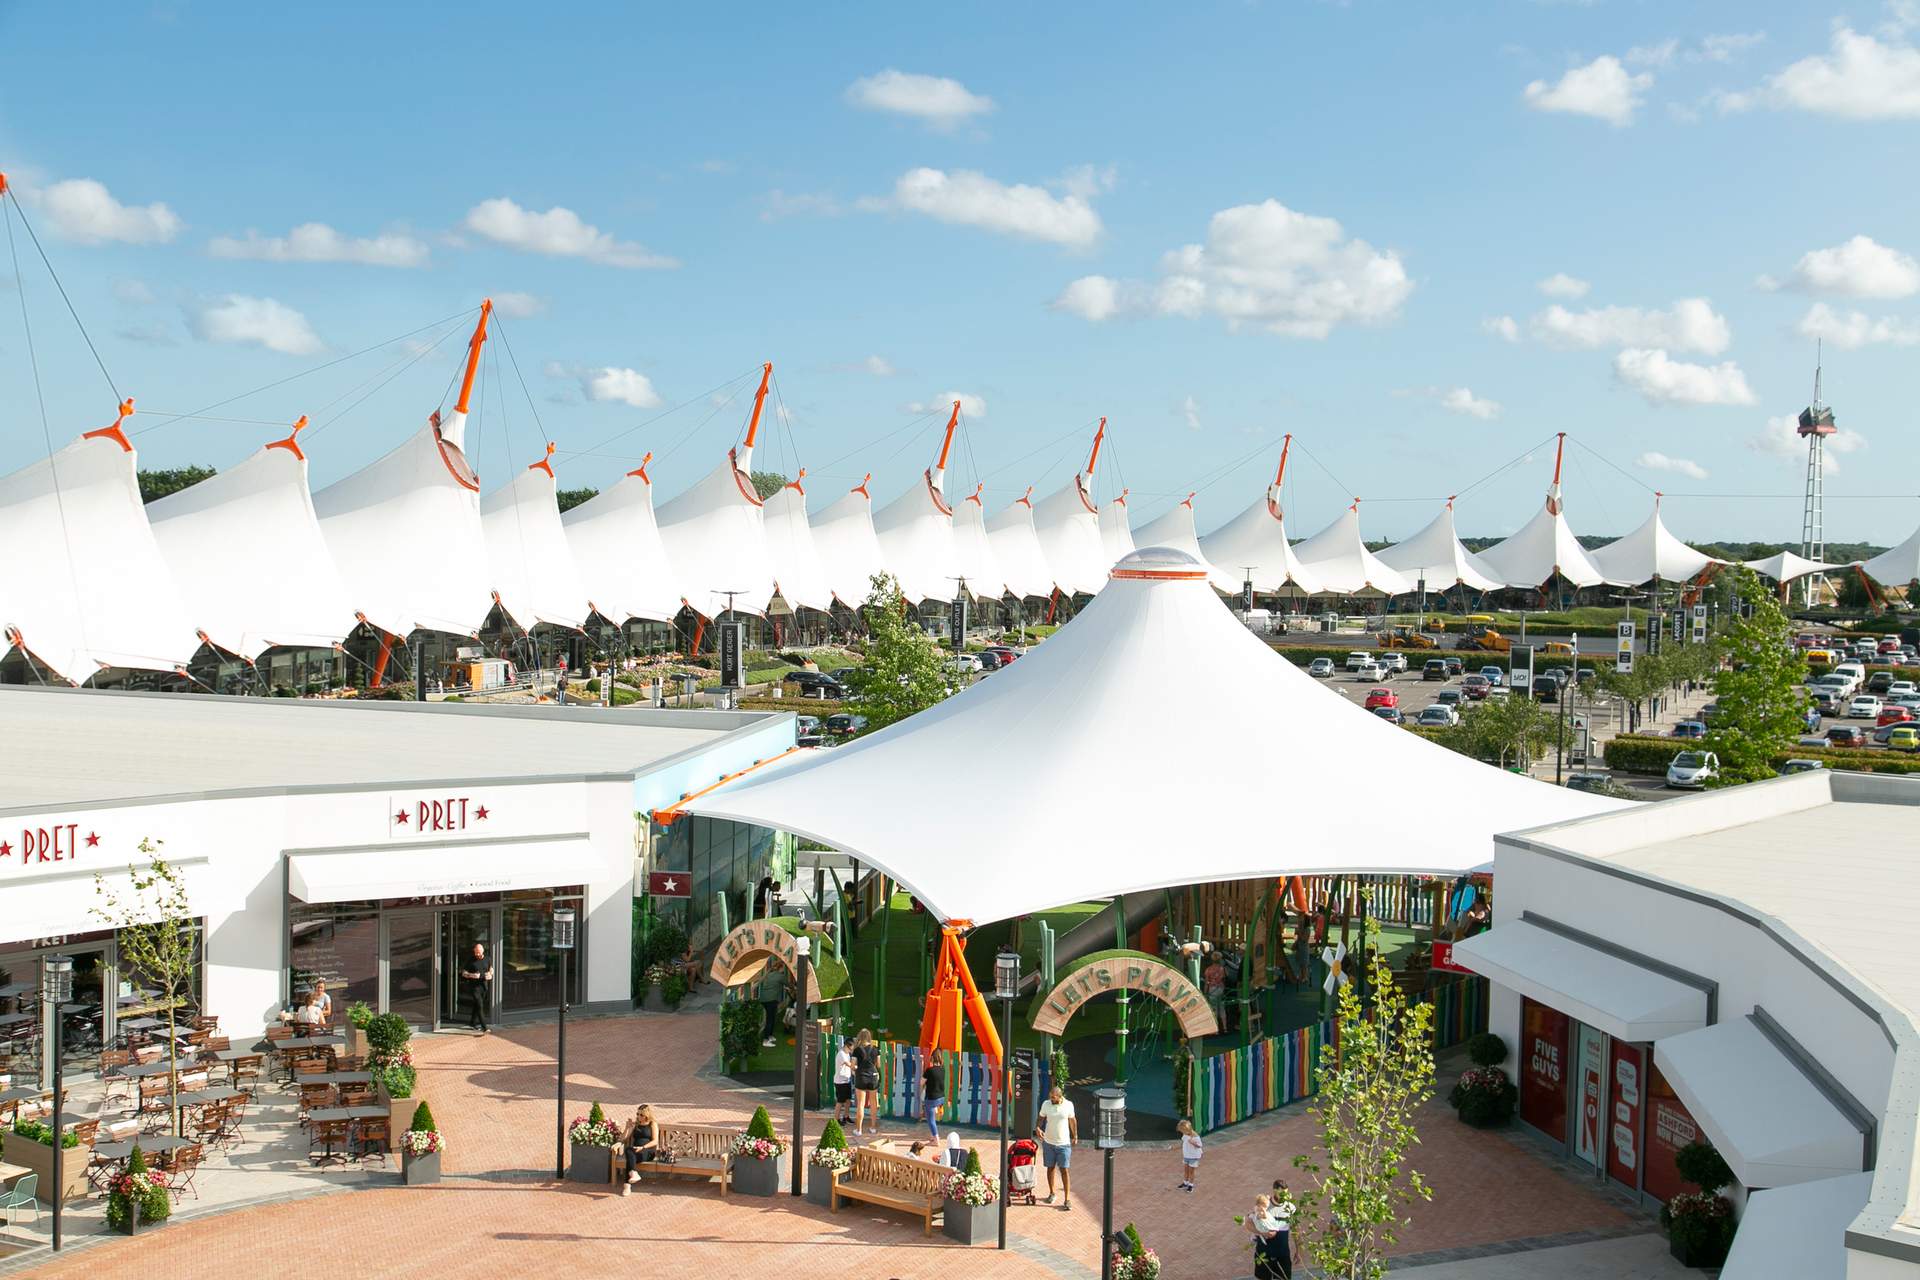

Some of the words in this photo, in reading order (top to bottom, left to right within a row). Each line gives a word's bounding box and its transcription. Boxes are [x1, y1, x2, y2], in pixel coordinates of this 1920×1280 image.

[726, 629, 734, 653] GEIGER
[1623, 625, 1630, 634] B
[726, 654, 734, 672] KURT
[418, 797, 469, 831] PRET
[22, 823, 78, 865] PRET
[718, 927, 756, 970] LET'S
[763, 928, 798, 970] PLA
[1050, 965, 1112, 1016] LET'S
[1127, 965, 1199, 1014] PLAY!
[1535, 1038, 1559, 1063] FIVE
[1531, 1054, 1561, 1082] GUYS
[1659, 1112, 1695, 1138] ASHFORD
